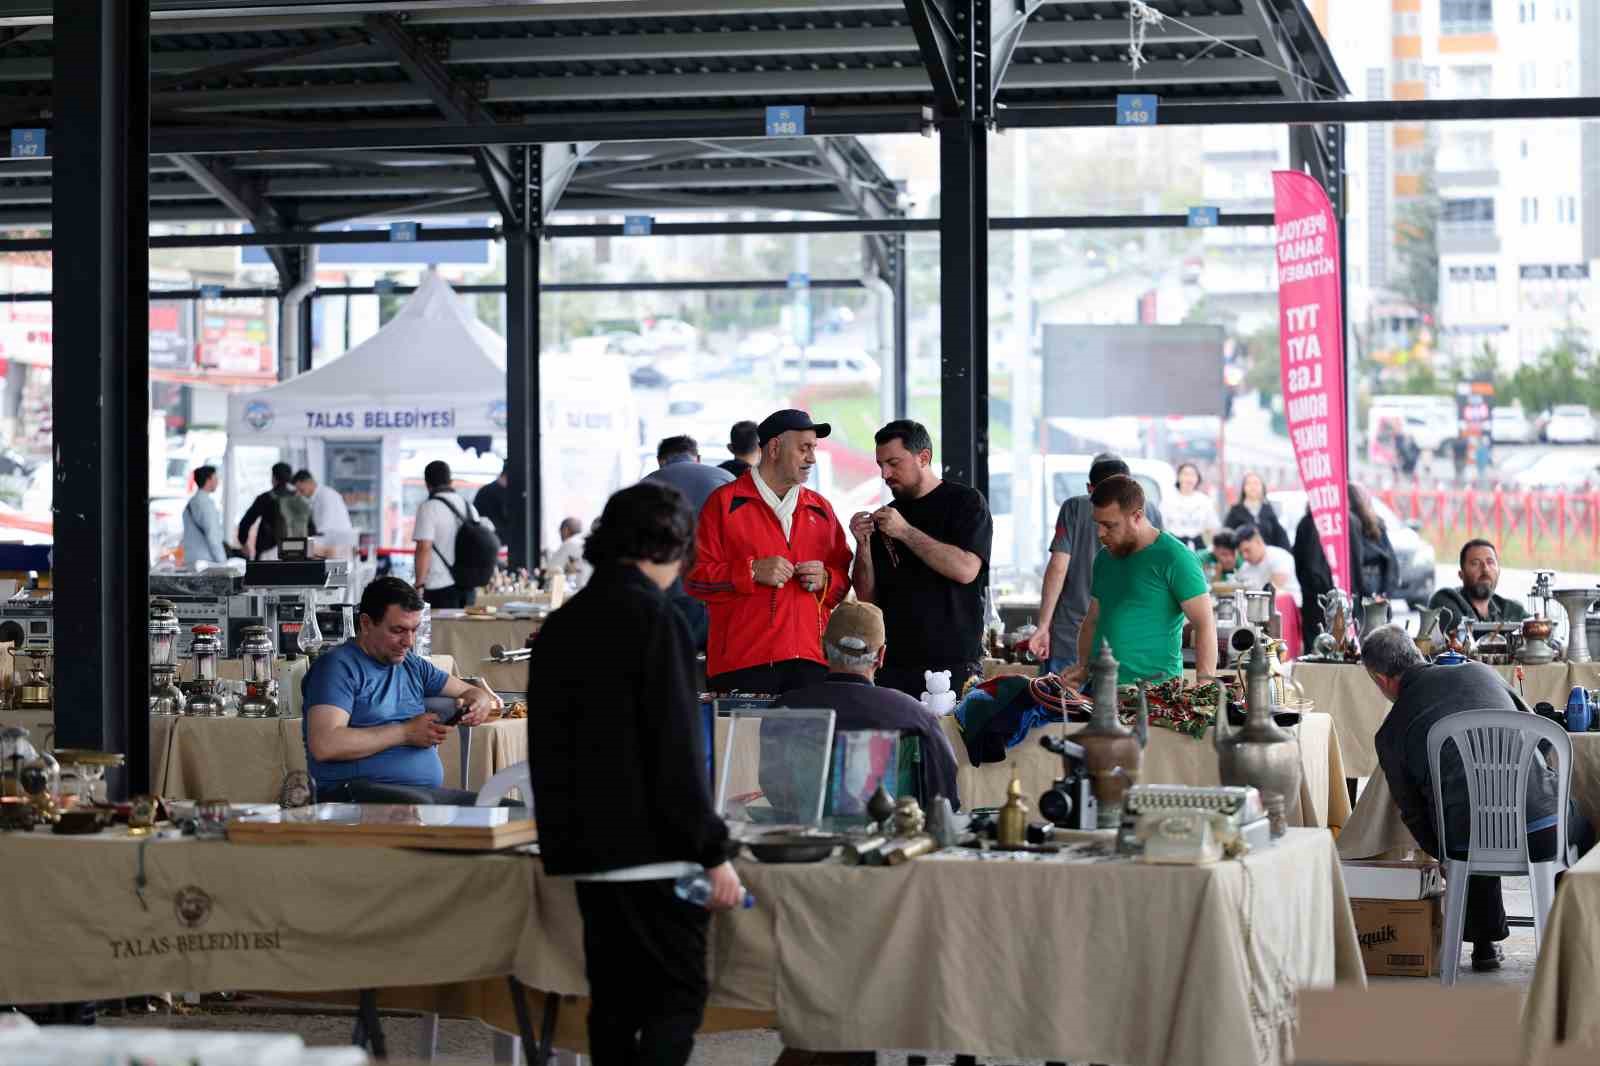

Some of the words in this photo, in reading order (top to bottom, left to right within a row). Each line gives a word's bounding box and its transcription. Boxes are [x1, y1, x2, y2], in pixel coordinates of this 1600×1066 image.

[305, 409, 354, 429] TALAS
[363, 407, 456, 429] BELEDİYESİ
[109, 936, 169, 959] TALAS
[176, 928, 281, 953] BELEDİYESİ
